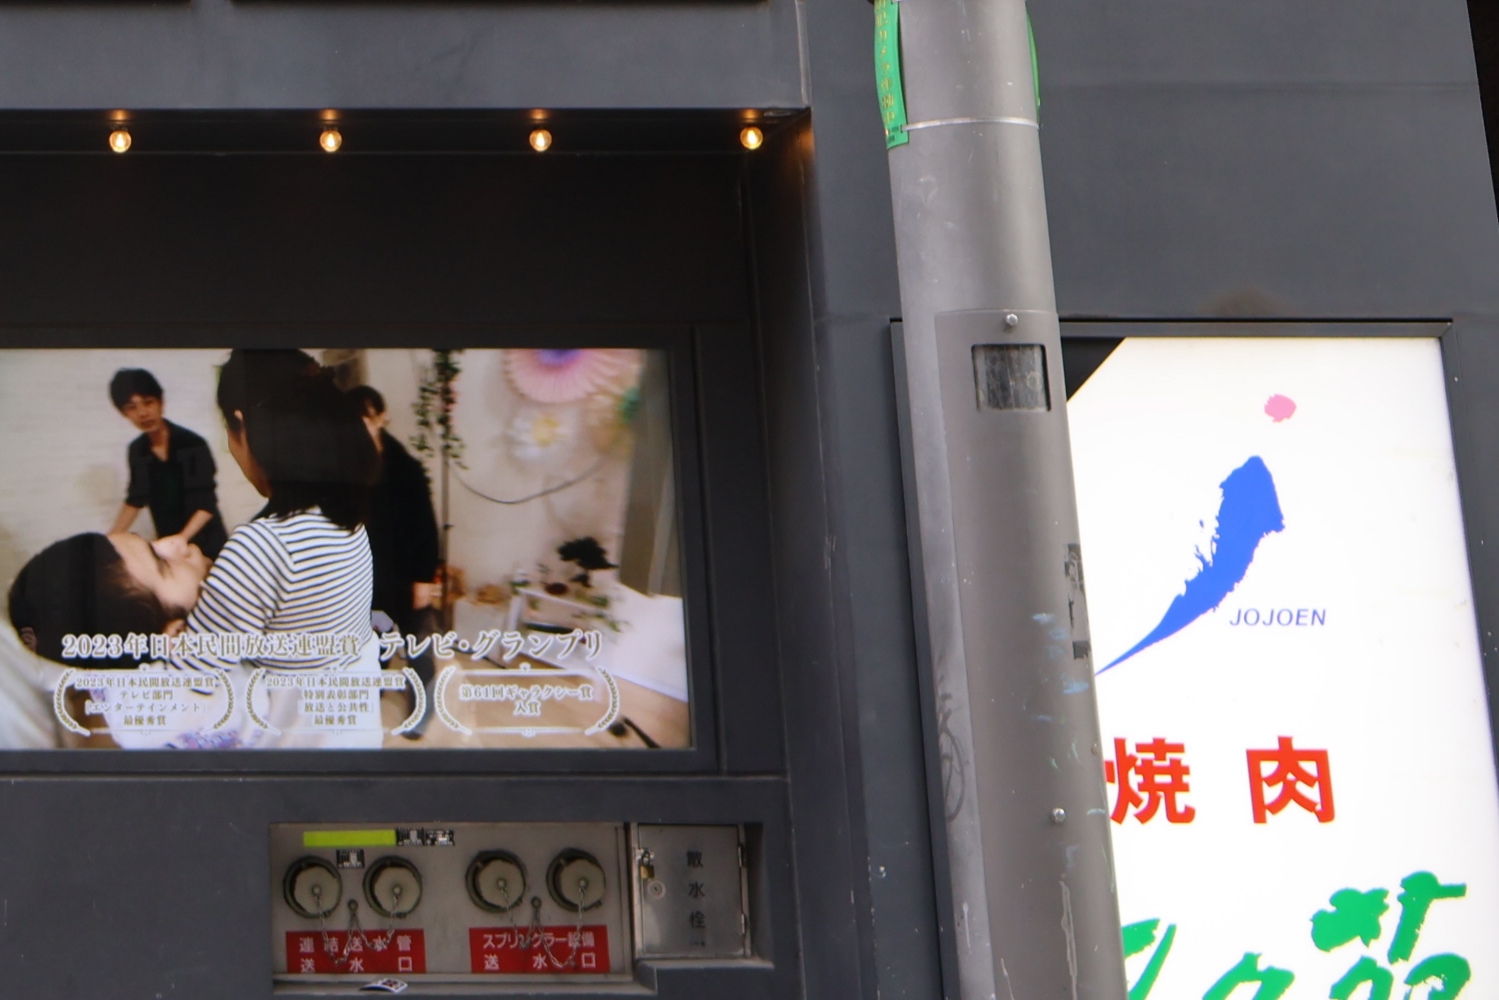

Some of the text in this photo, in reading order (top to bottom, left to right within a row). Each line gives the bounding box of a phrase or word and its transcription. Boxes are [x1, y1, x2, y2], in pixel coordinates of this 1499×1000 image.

[1228, 608, 1327, 628] JOJOEN
[61, 629, 603, 661] 2023年日本民間放送連盟賞 テレビ・グランプリ
[75, 676, 217, 688] 2023年日本民間放送連盟賞
[266, 676, 404, 688] 2023年日本民間放送連盟賞
[119, 689, 174, 700] テレビ部門
[303, 689, 369, 700] 特別表彰部門
[460, 685, 593, 700] 第61回ギャラクシー賞
[513, 701, 542, 716] 入賞
[122, 714, 167, 726] 最優秀賞
[314, 714, 357, 725] 最優秀賞
[1104, 736, 1337, 825] 焼肉
[301, 957, 413, 973] 送水口
[484, 952, 596, 971] 送水口
